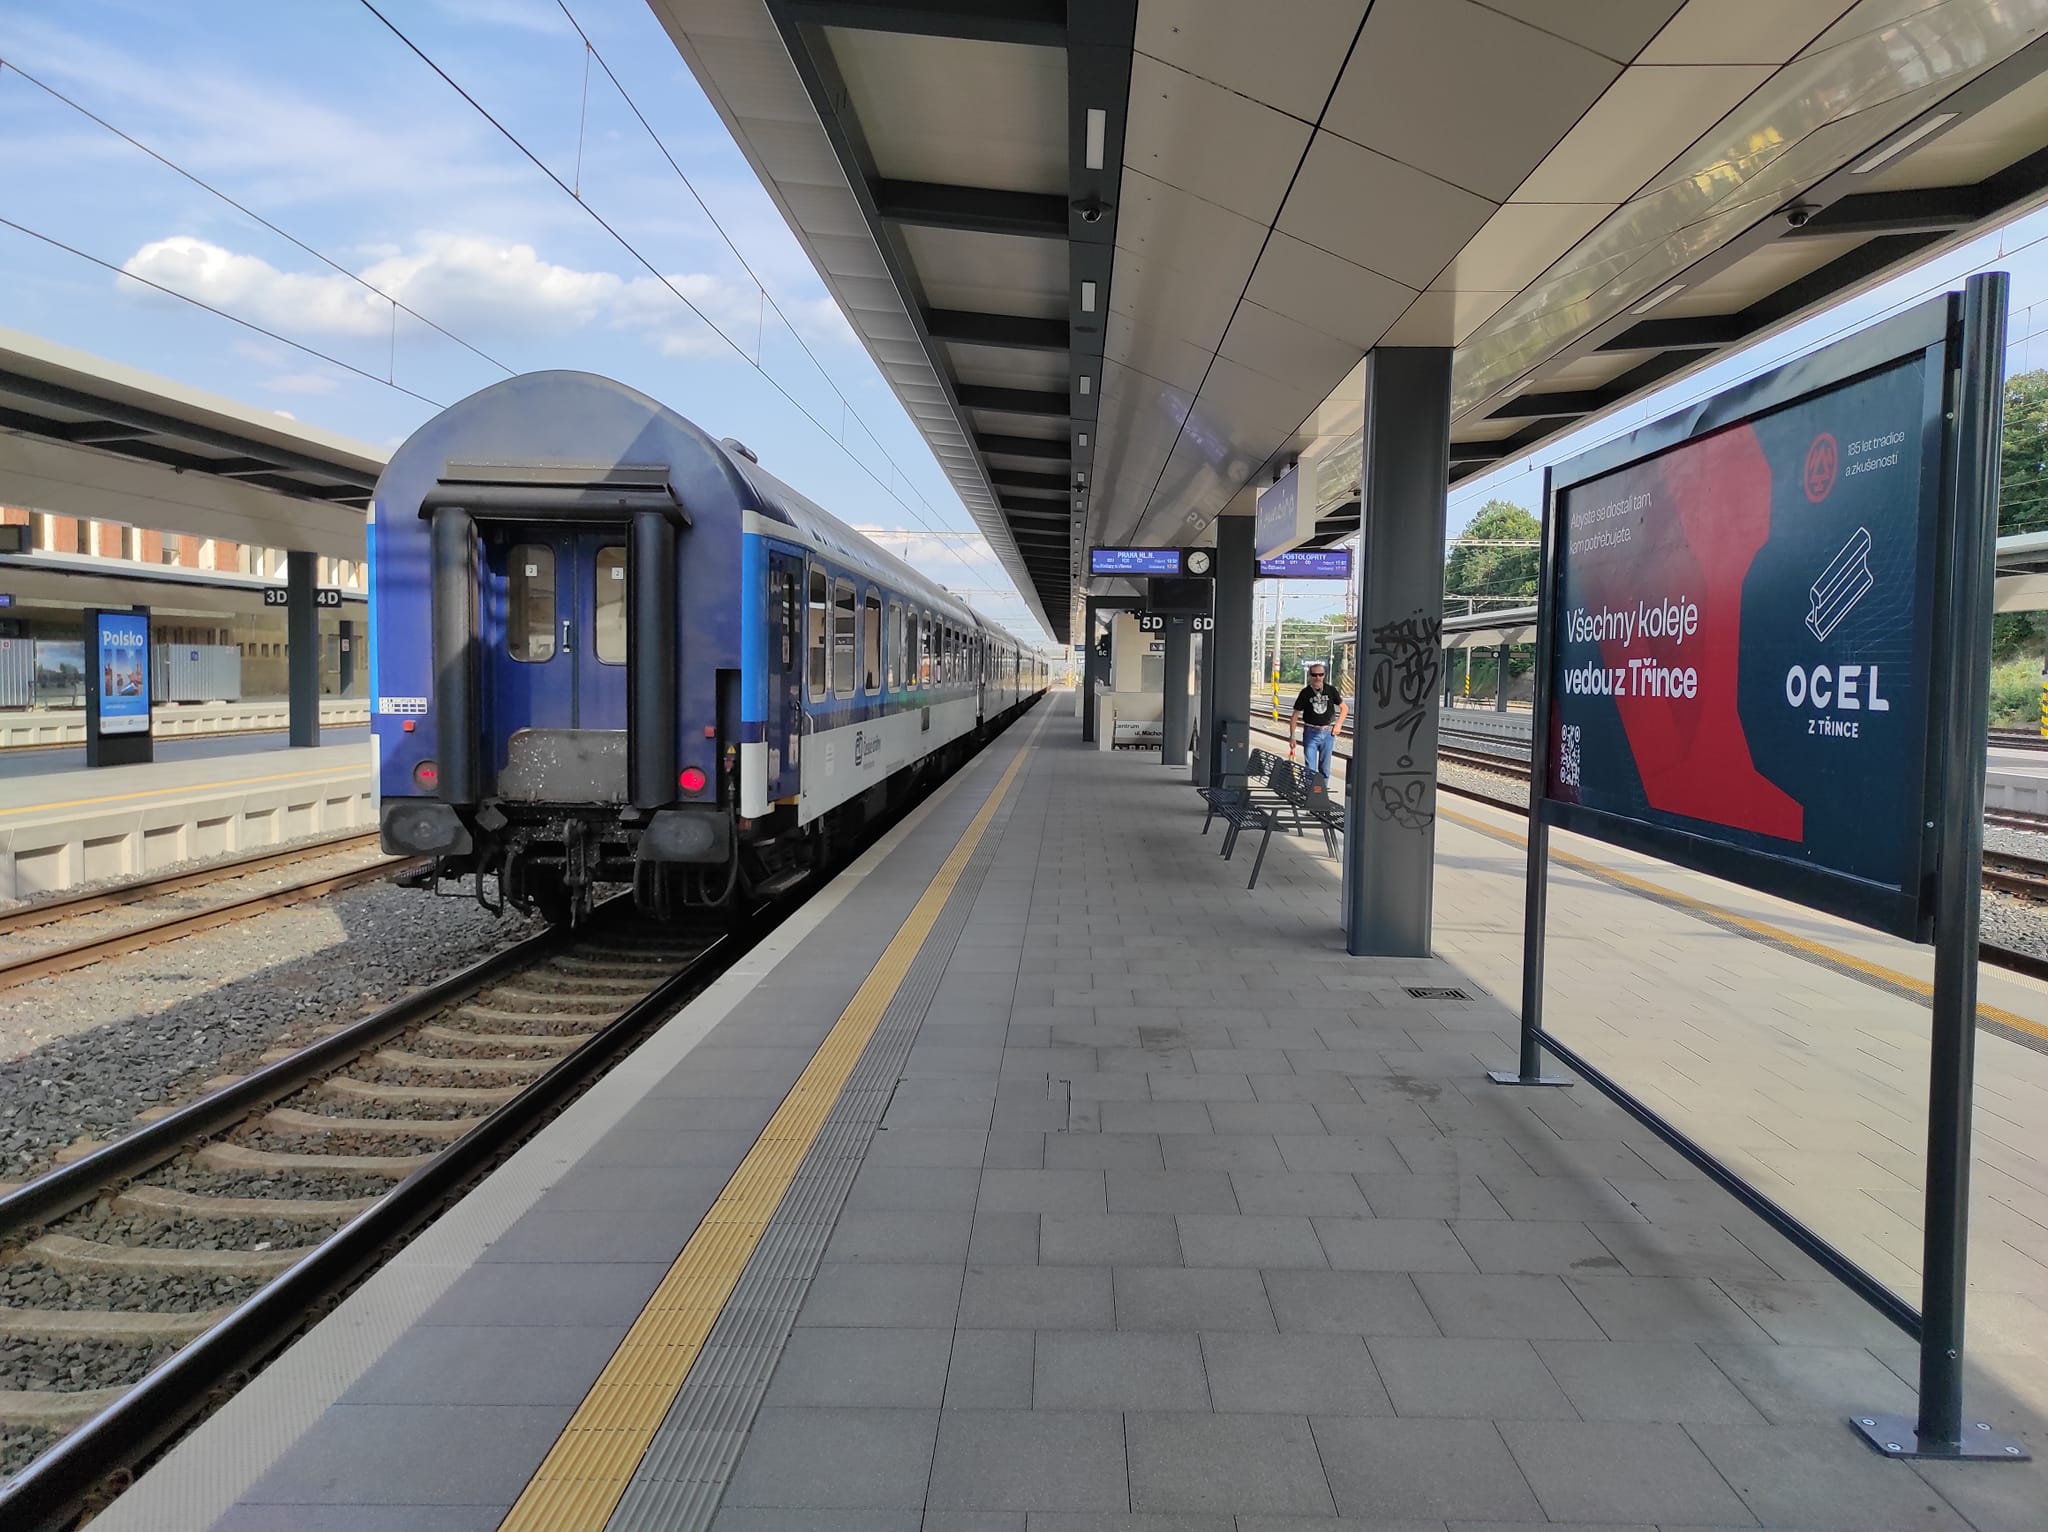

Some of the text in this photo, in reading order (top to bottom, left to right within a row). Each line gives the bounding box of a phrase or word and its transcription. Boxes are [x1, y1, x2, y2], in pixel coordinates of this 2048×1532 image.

[1861, 440, 1872, 452] let
[1873, 431, 1905, 449] tradice
[1845, 466, 1851, 476] a
[1571, 492, 1652, 530] Abyste se dostali tam,
[1569, 538, 1584, 555] kam
[267, 590, 288, 603] 3D
[317, 591, 339, 605] 4D
[1142, 617, 1163, 629] 5D
[1193, 617, 1214, 630] 6D
[1567, 595, 1698, 648] Všechny koleje
[103, 630, 144, 647] Polsko
[1565, 658, 1698, 699] vedou z Třince
[1786, 665, 1889, 711] OCEL
[1808, 716, 1859, 738] Z TŘINCE
